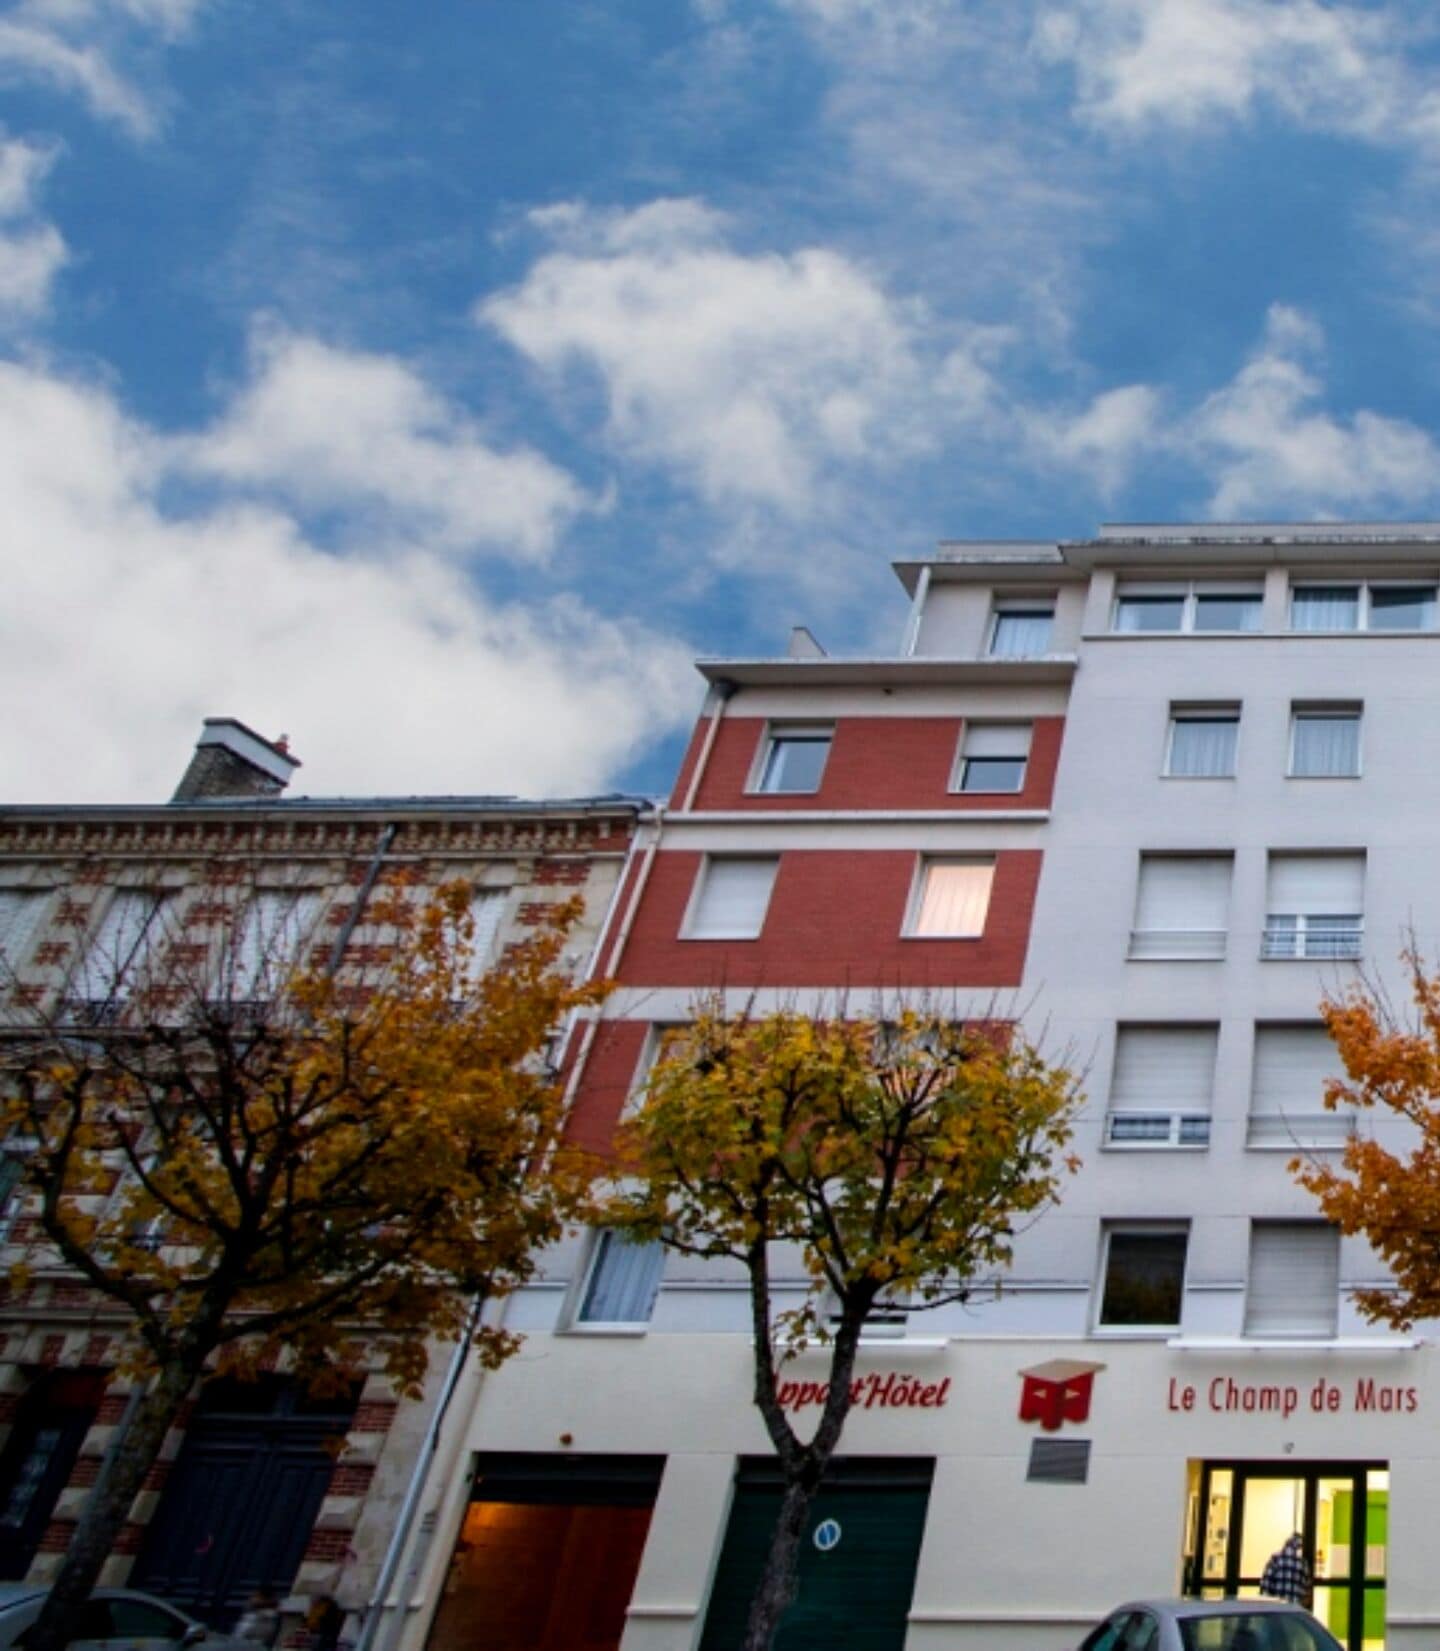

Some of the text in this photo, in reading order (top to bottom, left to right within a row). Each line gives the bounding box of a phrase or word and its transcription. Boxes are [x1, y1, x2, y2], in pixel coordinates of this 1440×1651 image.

[1168, 1378, 1418, 1418] Le Champ de Mars
